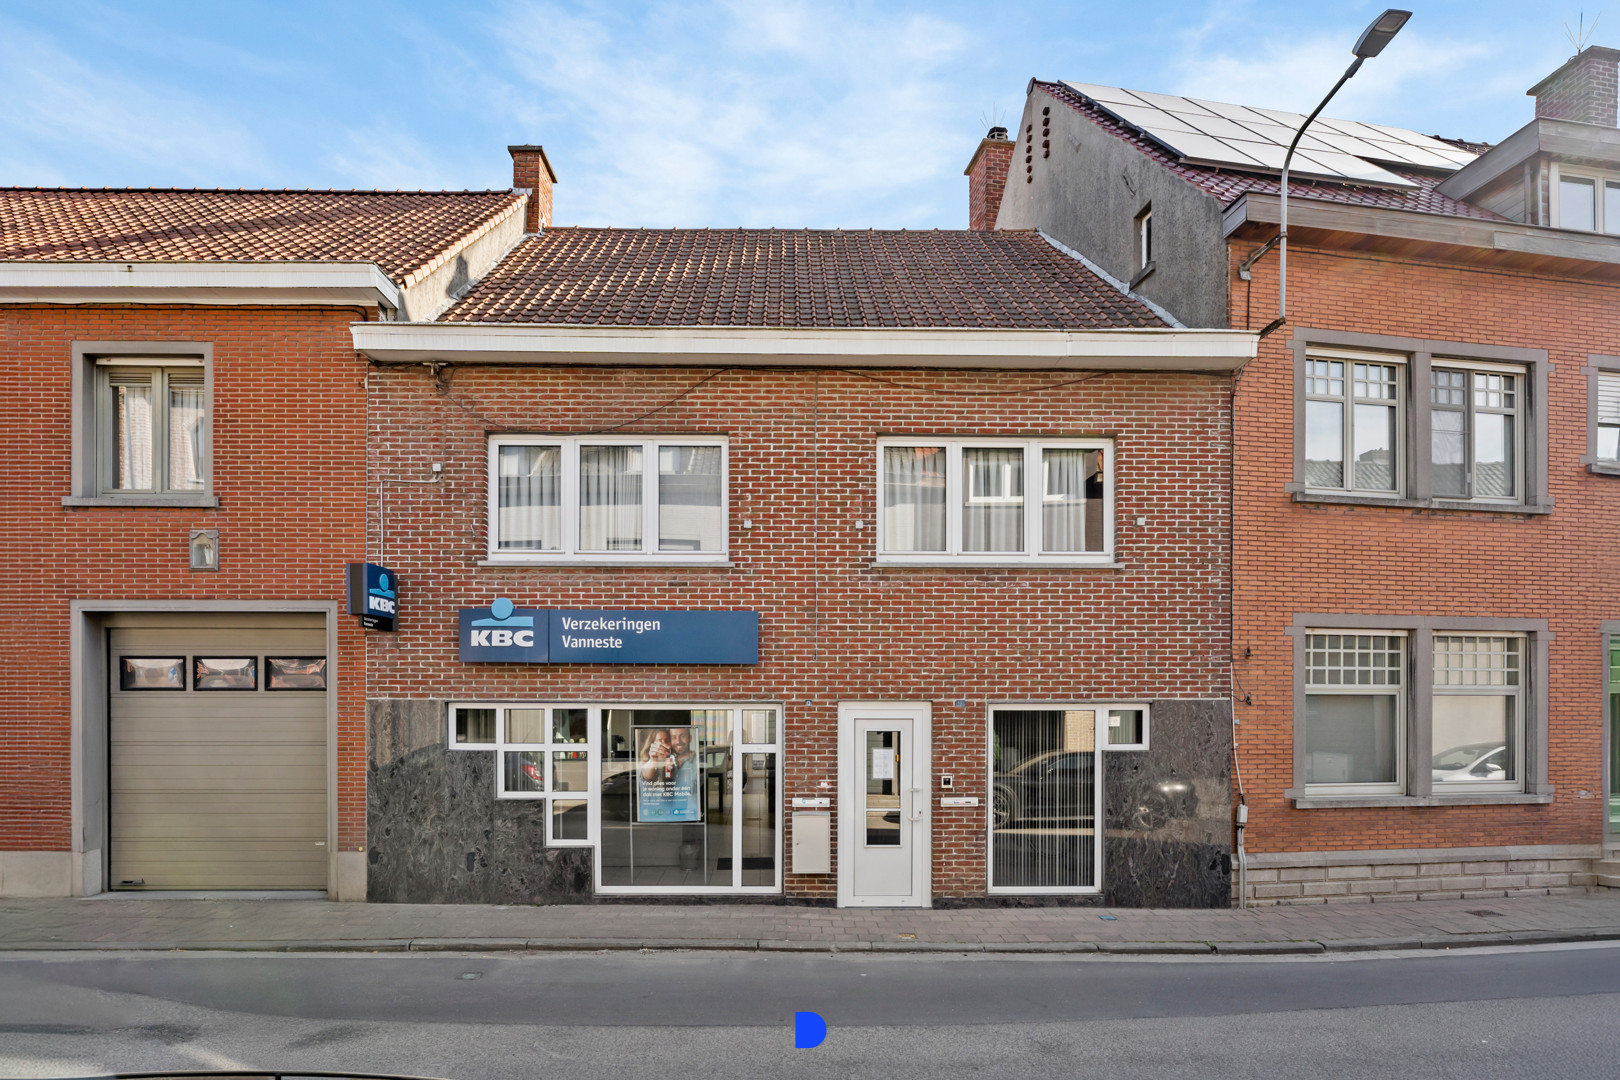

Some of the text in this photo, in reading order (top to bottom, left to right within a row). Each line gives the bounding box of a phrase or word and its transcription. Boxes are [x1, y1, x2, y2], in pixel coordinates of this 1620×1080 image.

[368, 596, 396, 614] KBC
[562, 616, 661, 633] Verzekeringen
[470, 629, 534, 648] KBC
[562, 634, 623, 649] Vanneste
